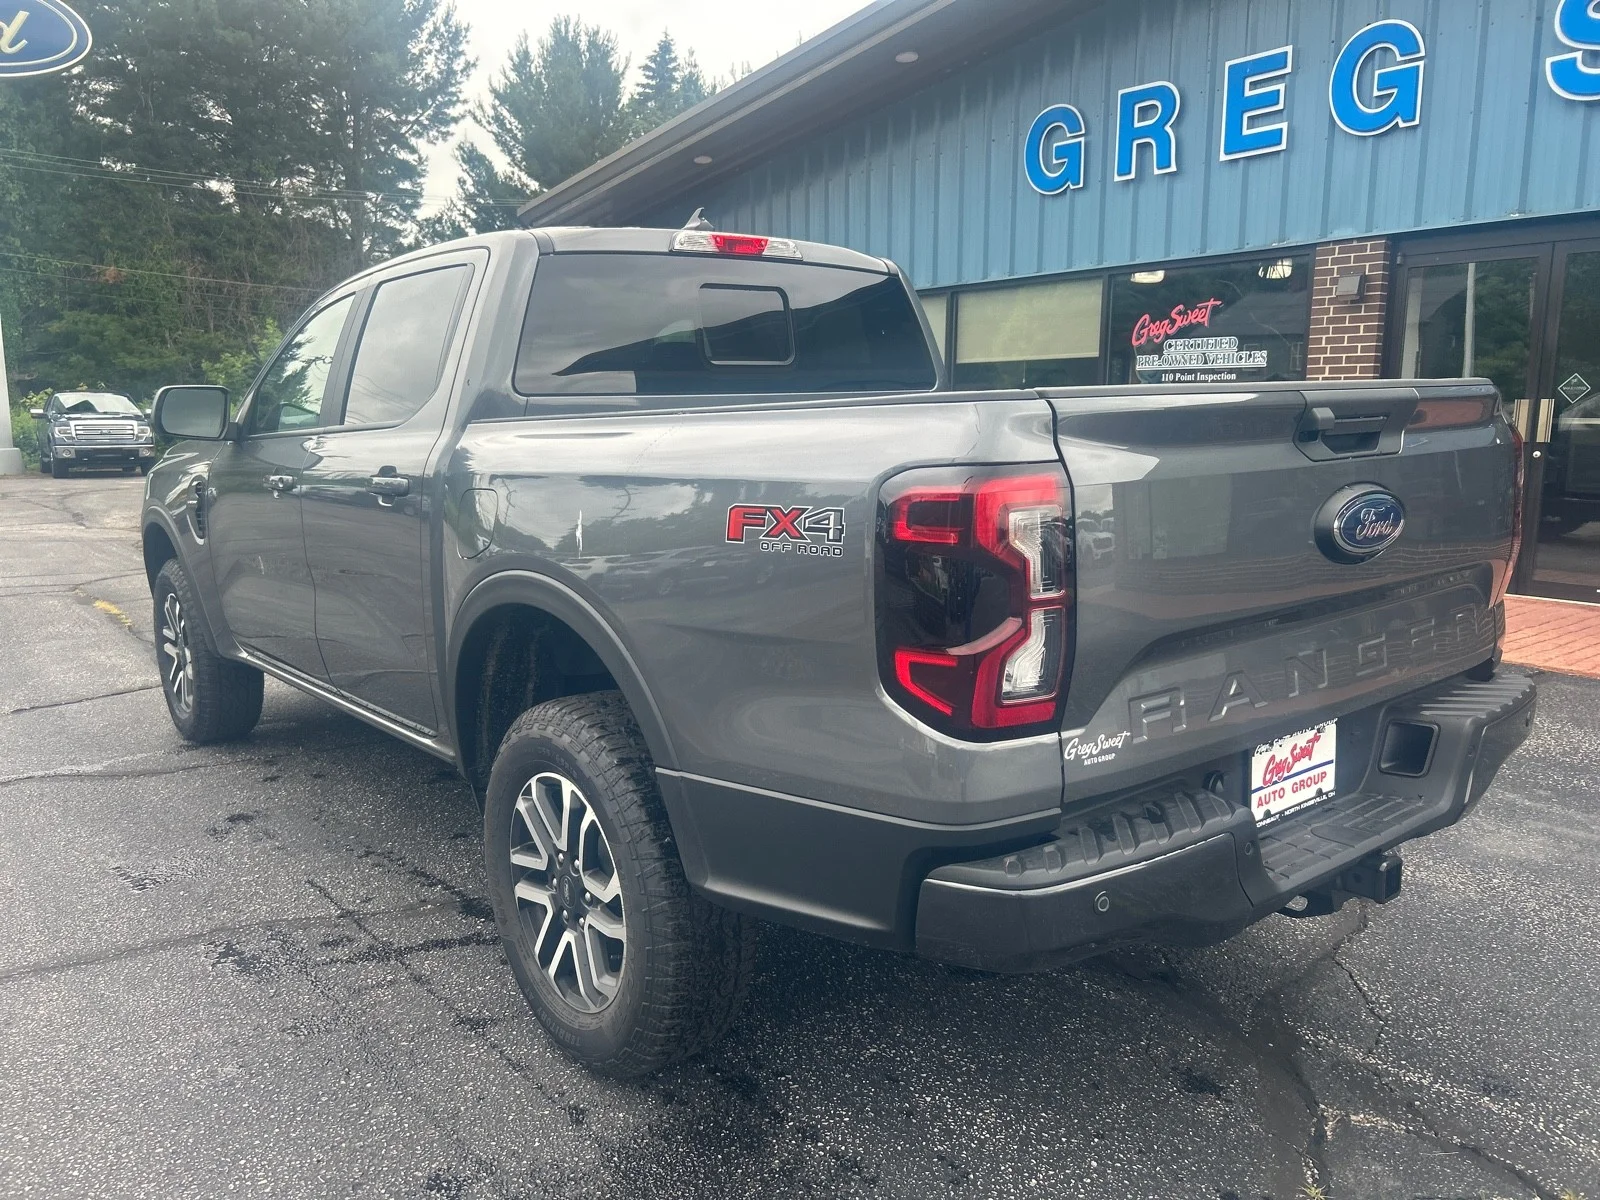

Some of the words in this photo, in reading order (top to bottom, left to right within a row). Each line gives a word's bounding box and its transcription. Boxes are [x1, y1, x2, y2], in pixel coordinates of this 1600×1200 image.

[1024, 19, 1426, 195] GREG
[1132, 313, 1170, 346] Greg
[1167, 297, 1223, 335] Sweet
[1164, 337, 1238, 352] CERTIFIED
[1137, 353, 1204, 368] PRE-OWNED
[1205, 351, 1267, 366] VEHICLES
[1161, 373, 1174, 382] 110
[1175, 373, 1195, 382] Point
[1197, 371, 1237, 383] Inspection
[725, 503, 845, 544] FX4
[1355, 506, 1394, 540] Ford
[760, 541, 792, 553] OFF
[797, 543, 844, 557] ROAD
[1064, 737, 1095, 760] Greg
[1092, 731, 1131, 754] Sweet
[1084, 757, 1098, 765] AUTO
[1098, 753, 1116, 762] GROUP
[1263, 754, 1288, 786] Greg
[1287, 732, 1322, 774] Sweet
[1257, 787, 1286, 809] AUTO
[1291, 771, 1327, 794] GROUP
[1284, 805, 1301, 816] NORTH
